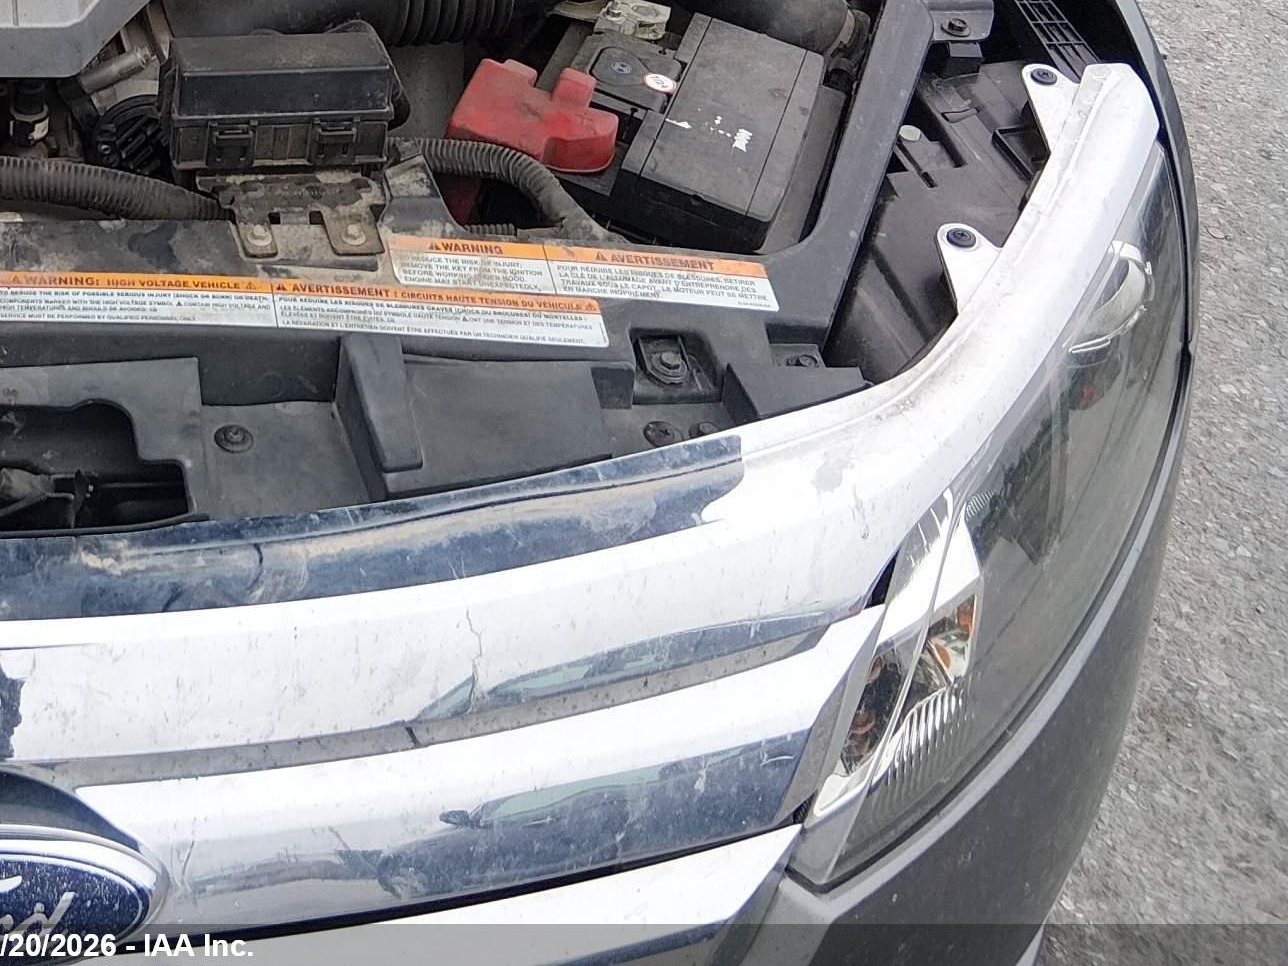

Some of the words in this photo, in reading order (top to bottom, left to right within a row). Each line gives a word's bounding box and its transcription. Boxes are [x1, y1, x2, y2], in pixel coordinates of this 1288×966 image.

[441, 241, 504, 255] WARNING
[557, 263, 577, 271] POUR
[611, 253, 714, 270] AVERTISSEMENT
[402, 268, 433, 276] BEFORE
[509, 268, 542, 276] IGNITION
[24, 275, 98, 286] WARNING:
[106, 277, 134, 287] HIGH
[138, 278, 191, 289] VOLTAGE
[192, 280, 240, 290] VEHICLE
[292, 283, 389, 297] AVERTISSEMENT
[400, 290, 442, 301] CIRCUITS
[446, 294, 476, 303] HAUTE
[479, 296, 518, 306] TENSION
[521, 299, 533, 307] DU
